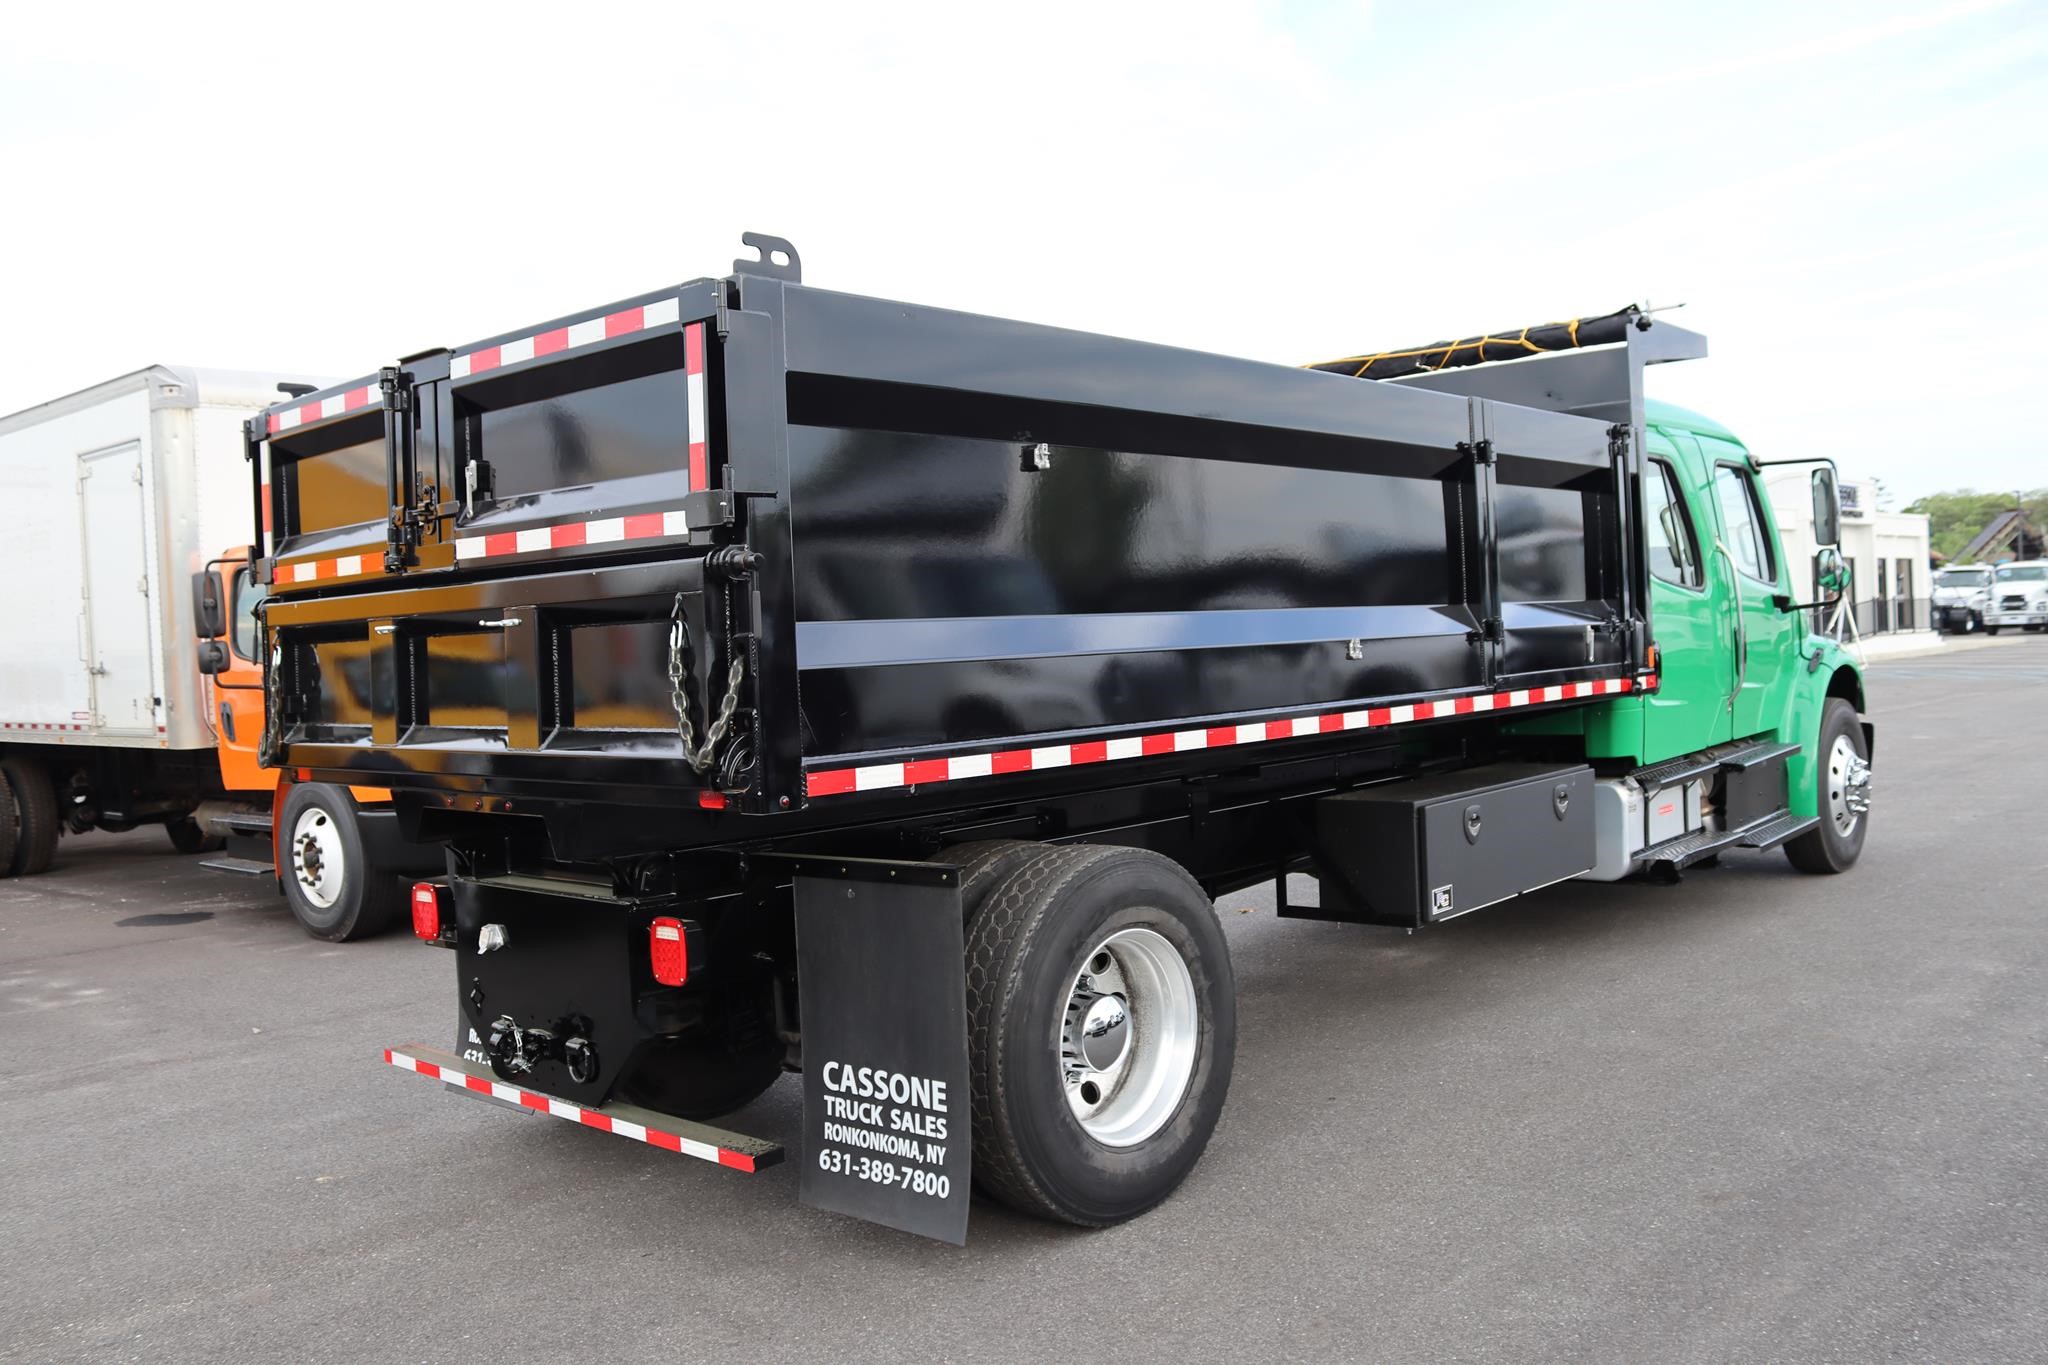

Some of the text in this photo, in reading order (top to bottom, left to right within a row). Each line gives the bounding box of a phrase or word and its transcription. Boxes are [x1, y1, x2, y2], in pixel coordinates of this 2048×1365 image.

[822, 1061, 948, 1113] CASSONE
[823, 1094, 948, 1140] TRUCK SALES
[823, 1121, 947, 1166] RONKONKOMA, NY
[818, 1148, 950, 1199] 631-389-7800
